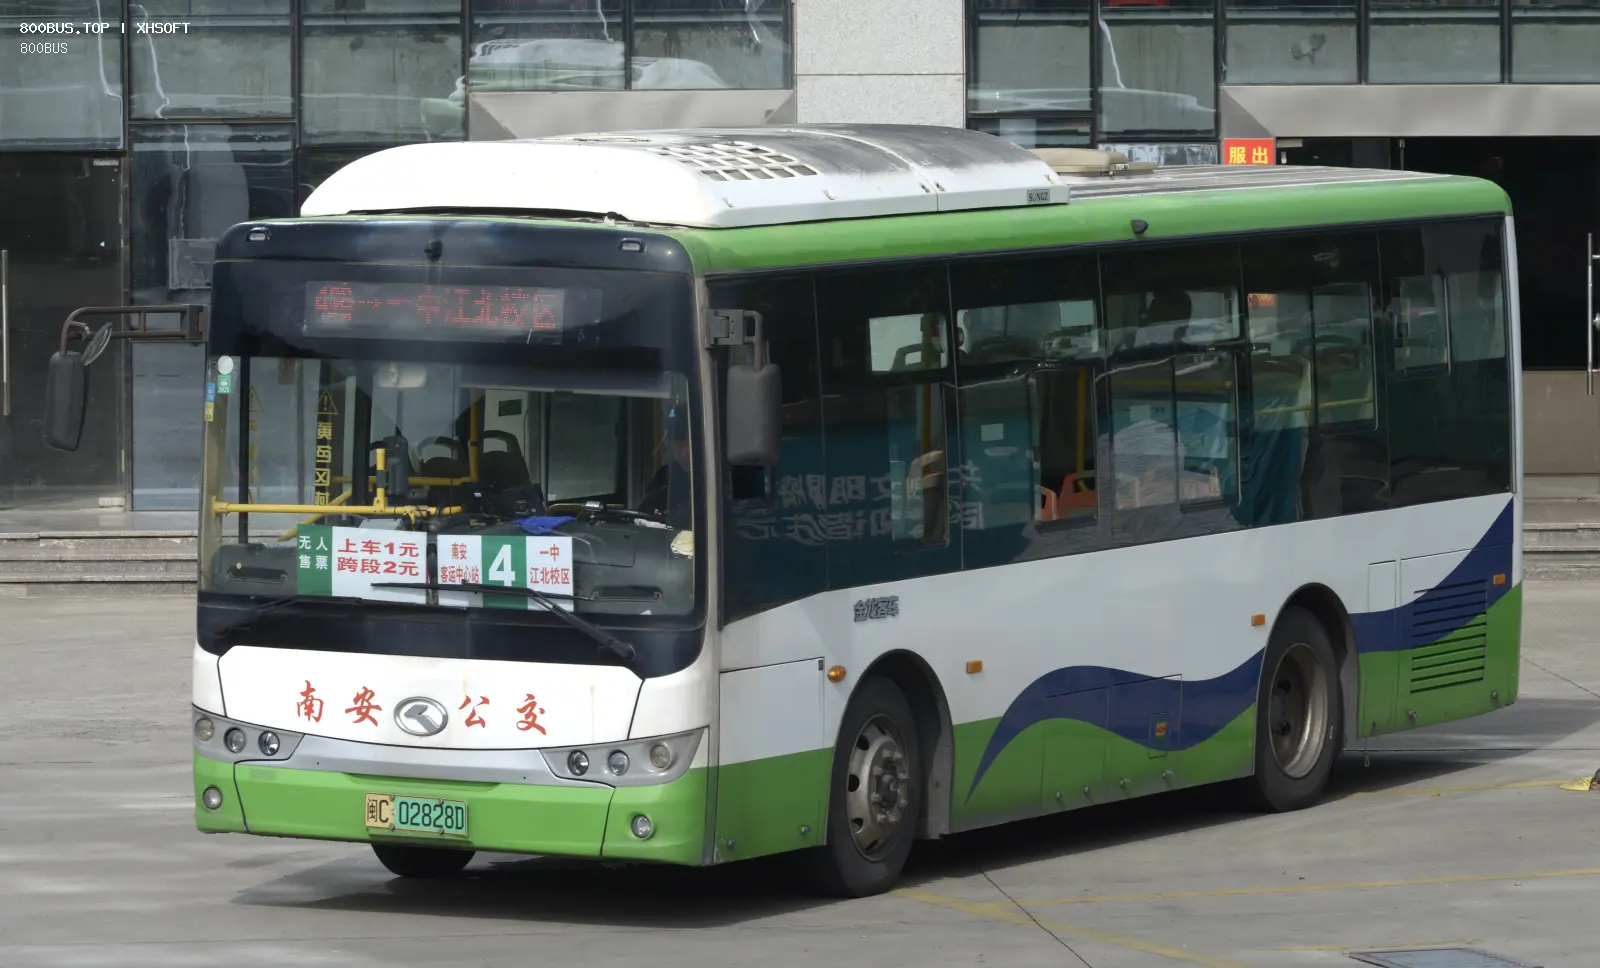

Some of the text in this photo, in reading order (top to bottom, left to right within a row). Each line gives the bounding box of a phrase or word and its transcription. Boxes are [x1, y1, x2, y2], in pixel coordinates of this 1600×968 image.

[299, 535, 328, 551] 无人
[338, 538, 419, 558] 上车1元
[451, 542, 468, 560] 南安
[540, 544, 560, 561] 一中
[337, 556, 419, 577] 跨段2元
[440, 565, 480, 584] 客运中心站
[488, 544, 516, 587] 4
[530, 566, 571, 585] 江北校区
